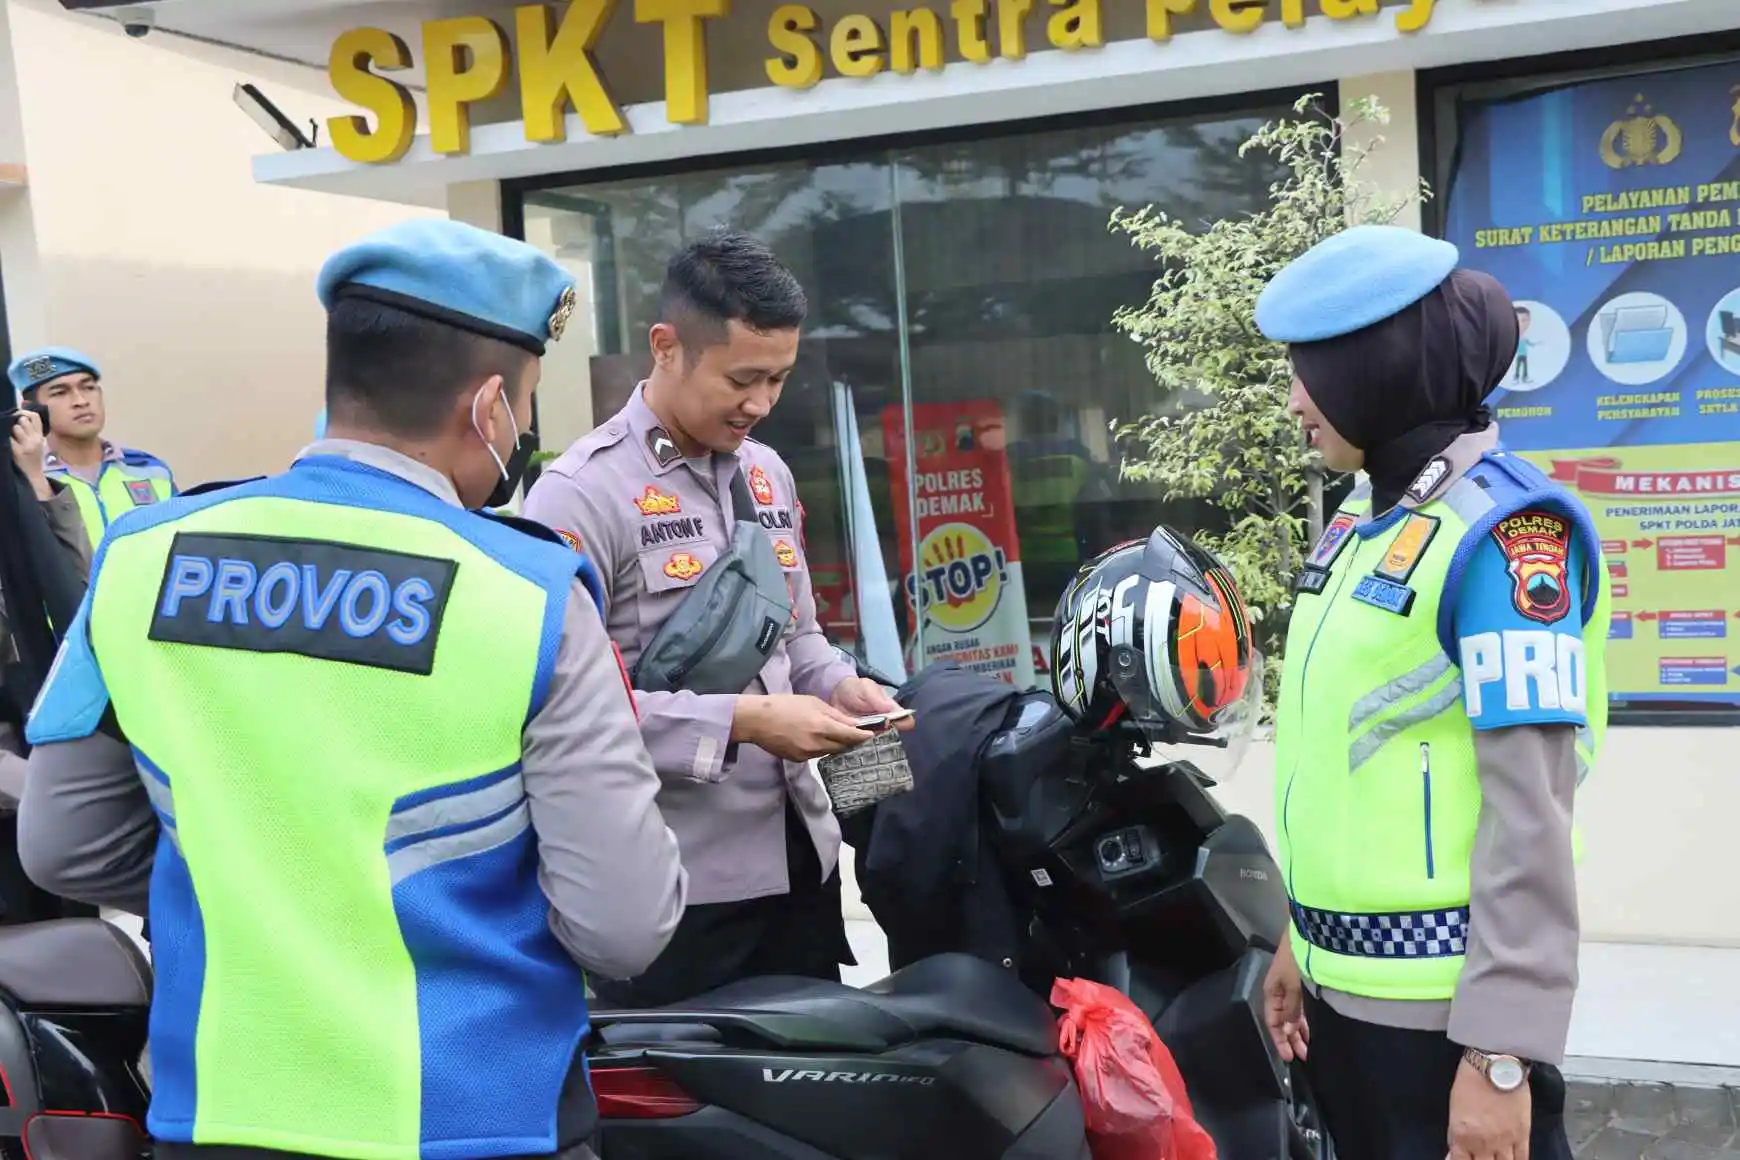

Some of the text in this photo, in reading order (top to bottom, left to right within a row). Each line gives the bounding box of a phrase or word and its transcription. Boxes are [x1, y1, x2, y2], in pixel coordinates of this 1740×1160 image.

[327, 0, 730, 163] SPKT
[765, 0, 1103, 88] Sentra
[1582, 186, 1690, 214] PELAYANAN
[1475, 226, 1533, 248] SURAT
[1539, 215, 1661, 243] KETERANGAN
[1668, 209, 1731, 232] TANDA
[1600, 239, 1685, 264] LAPORAN
[915, 468, 983, 495] POLRES
[1615, 474, 1740, 492] MEKANIS
[917, 493, 986, 518] DEMAK
[1606, 503, 1740, 518] PENERIMAAN LAPOR
[641, 518, 695, 546] ANTON
[758, 510, 793, 529] OLRI
[1499, 515, 1563, 533] POLRES
[1508, 526, 1557, 538] DEMAK
[1640, 520, 1672, 531] SPKT
[1675, 519, 1718, 530] POLDA
[906, 549, 1008, 607] STOP!
[160, 554, 435, 646] PROVOS
[1459, 629, 1587, 718] PRO
